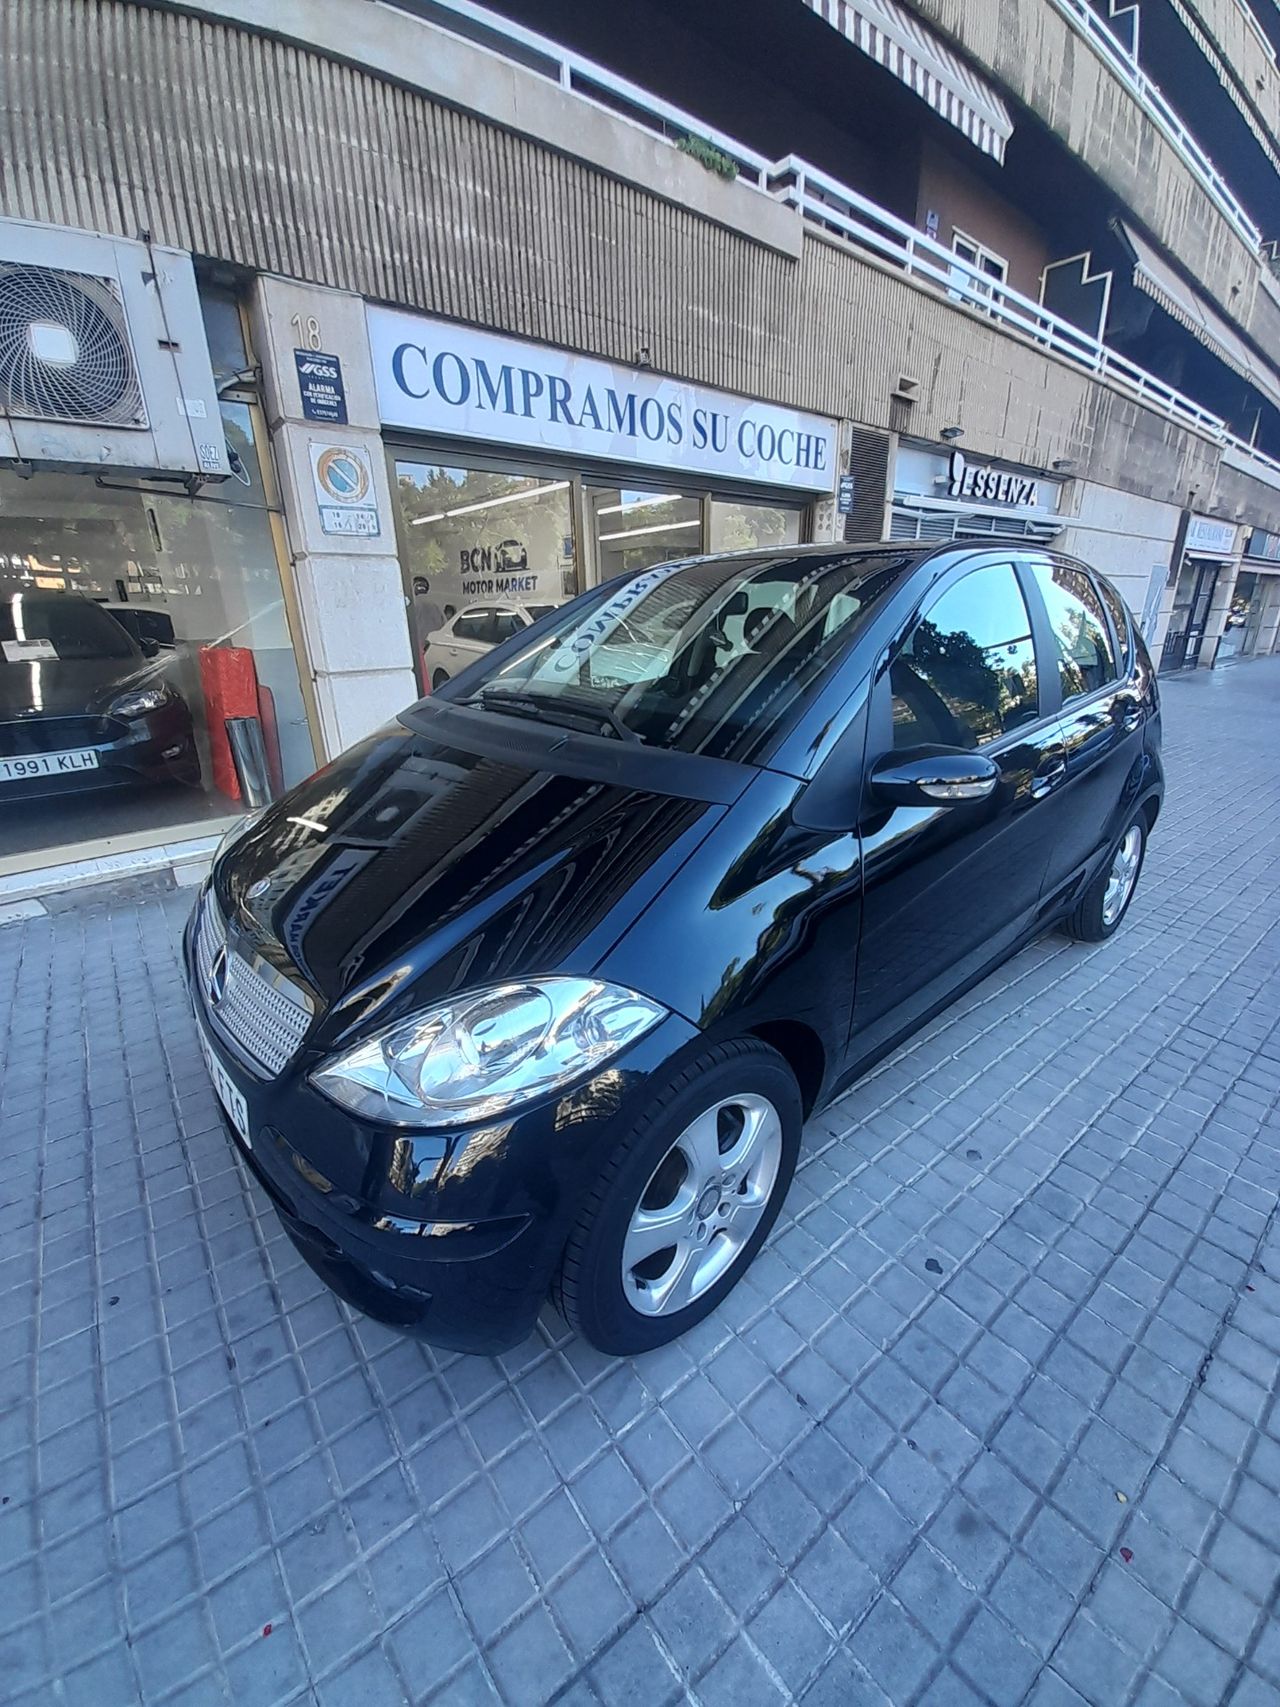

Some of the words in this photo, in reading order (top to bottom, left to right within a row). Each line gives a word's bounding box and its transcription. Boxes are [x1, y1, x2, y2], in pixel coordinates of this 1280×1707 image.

[291, 313, 321, 351] 18
[312, 364, 338, 379] GSS
[391, 342, 683, 445] COMPRAMOS
[692, 408, 729, 453] SU
[737, 419, 827, 471] COCHE
[460, 546, 491, 574] BCN
[462, 579, 494, 595] MOTOR
[496, 575, 538, 593] MARKET
[3, 758, 50, 777] 1991
[57, 752, 94, 770] KLH
